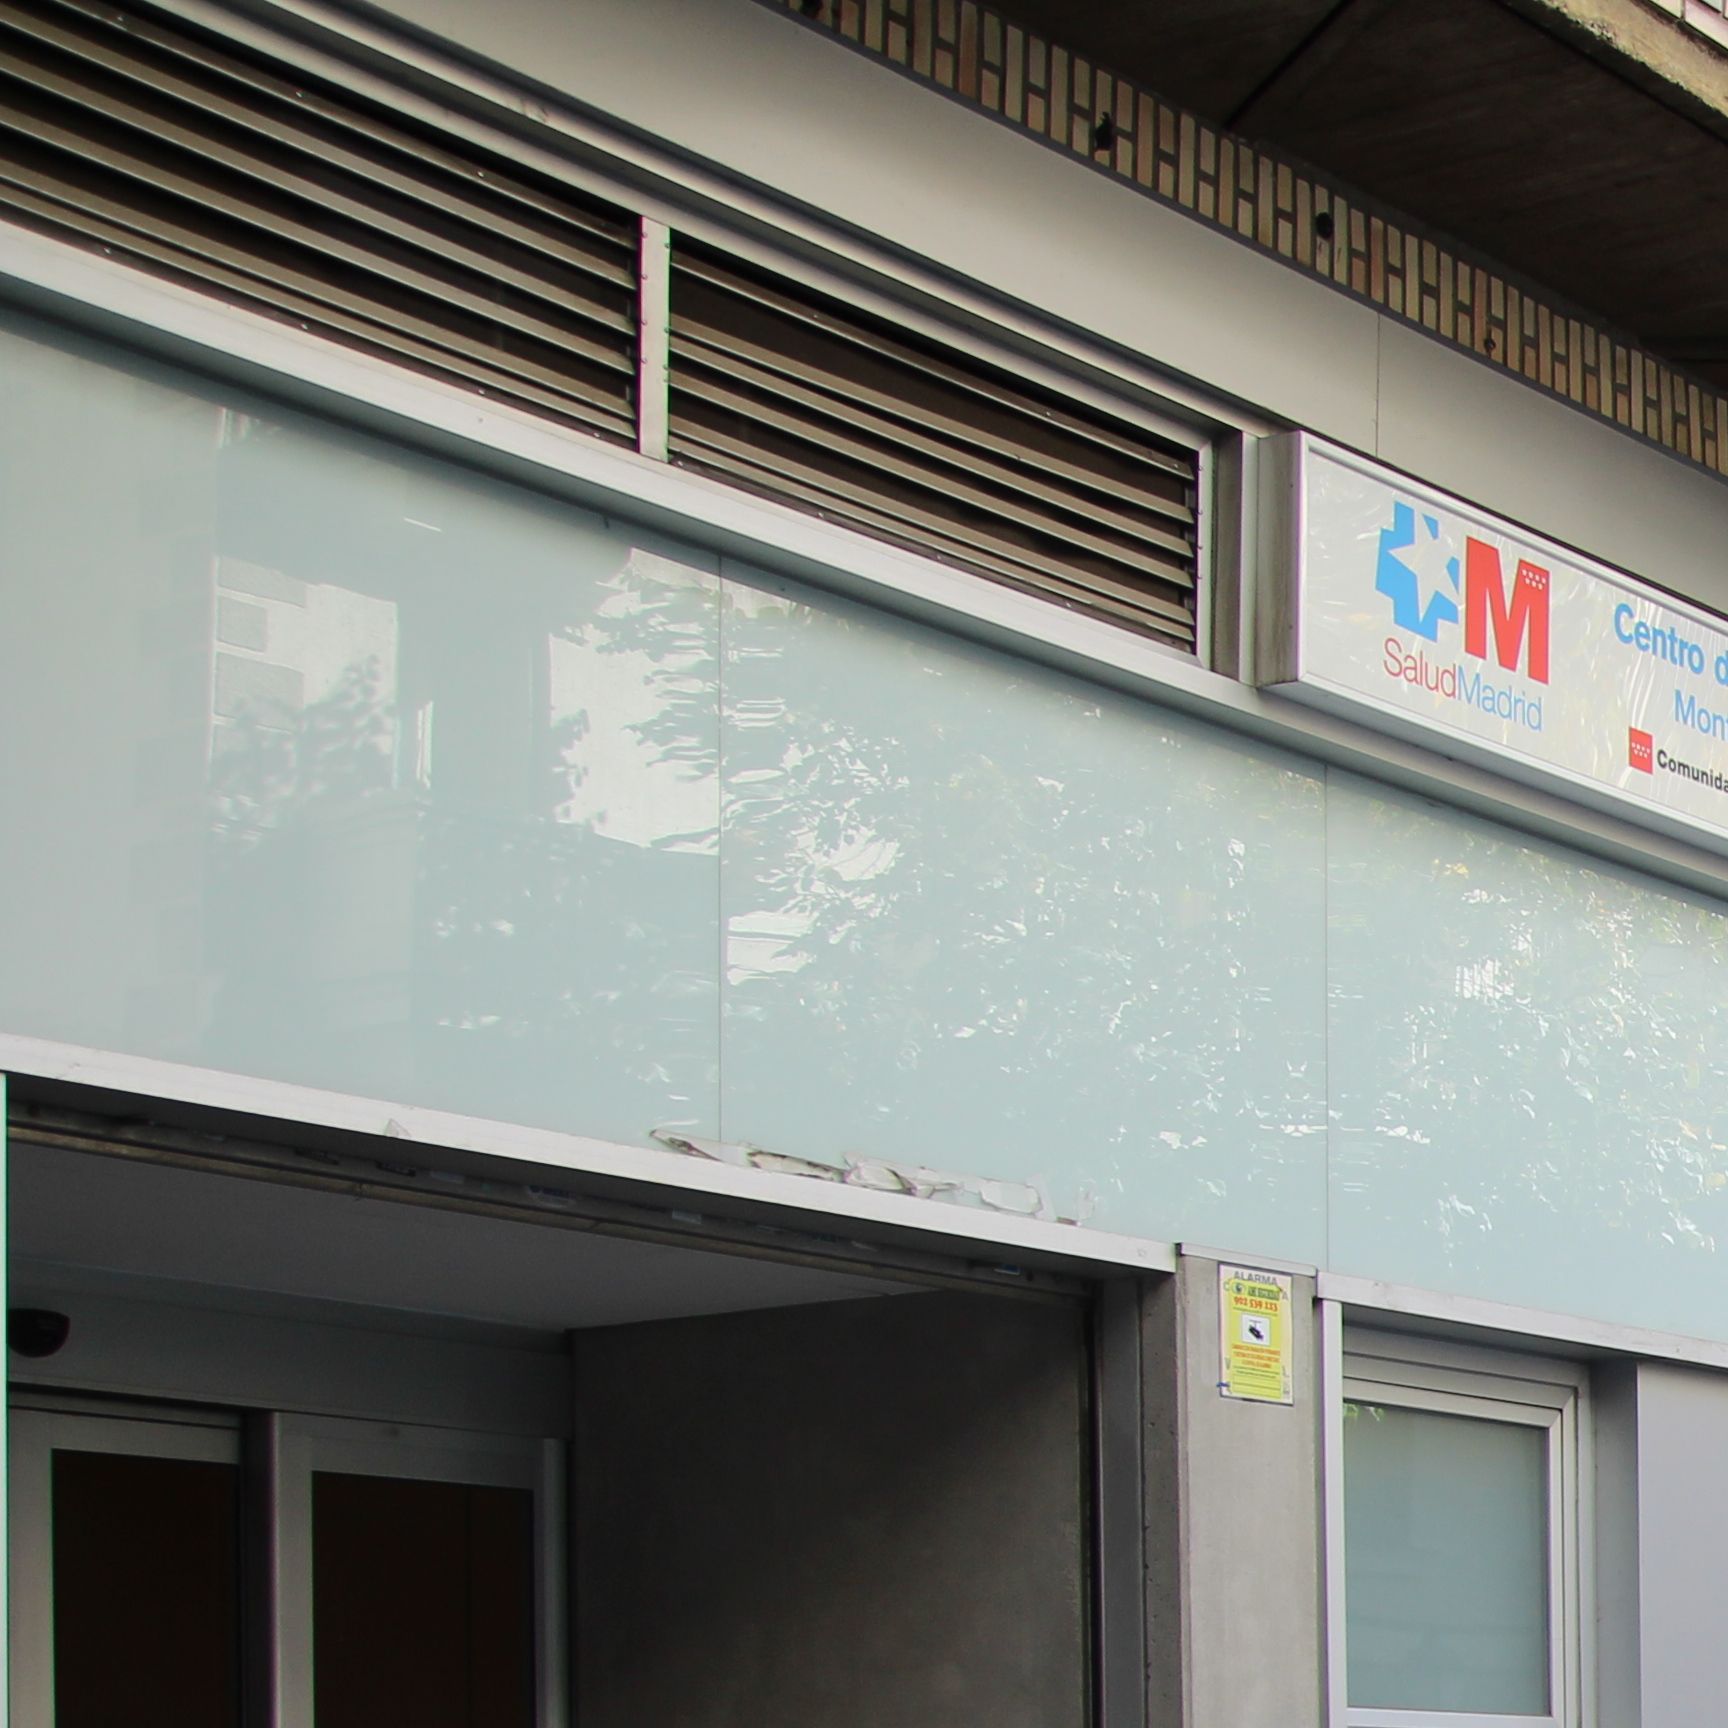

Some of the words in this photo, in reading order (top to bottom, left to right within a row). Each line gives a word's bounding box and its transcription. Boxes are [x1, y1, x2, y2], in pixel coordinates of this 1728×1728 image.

[1613, 602, 1705, 674] Centro
[1383, 637, 1543, 731] SaludMadrid
[1234, 1271, 1277, 1286] ALARMA
